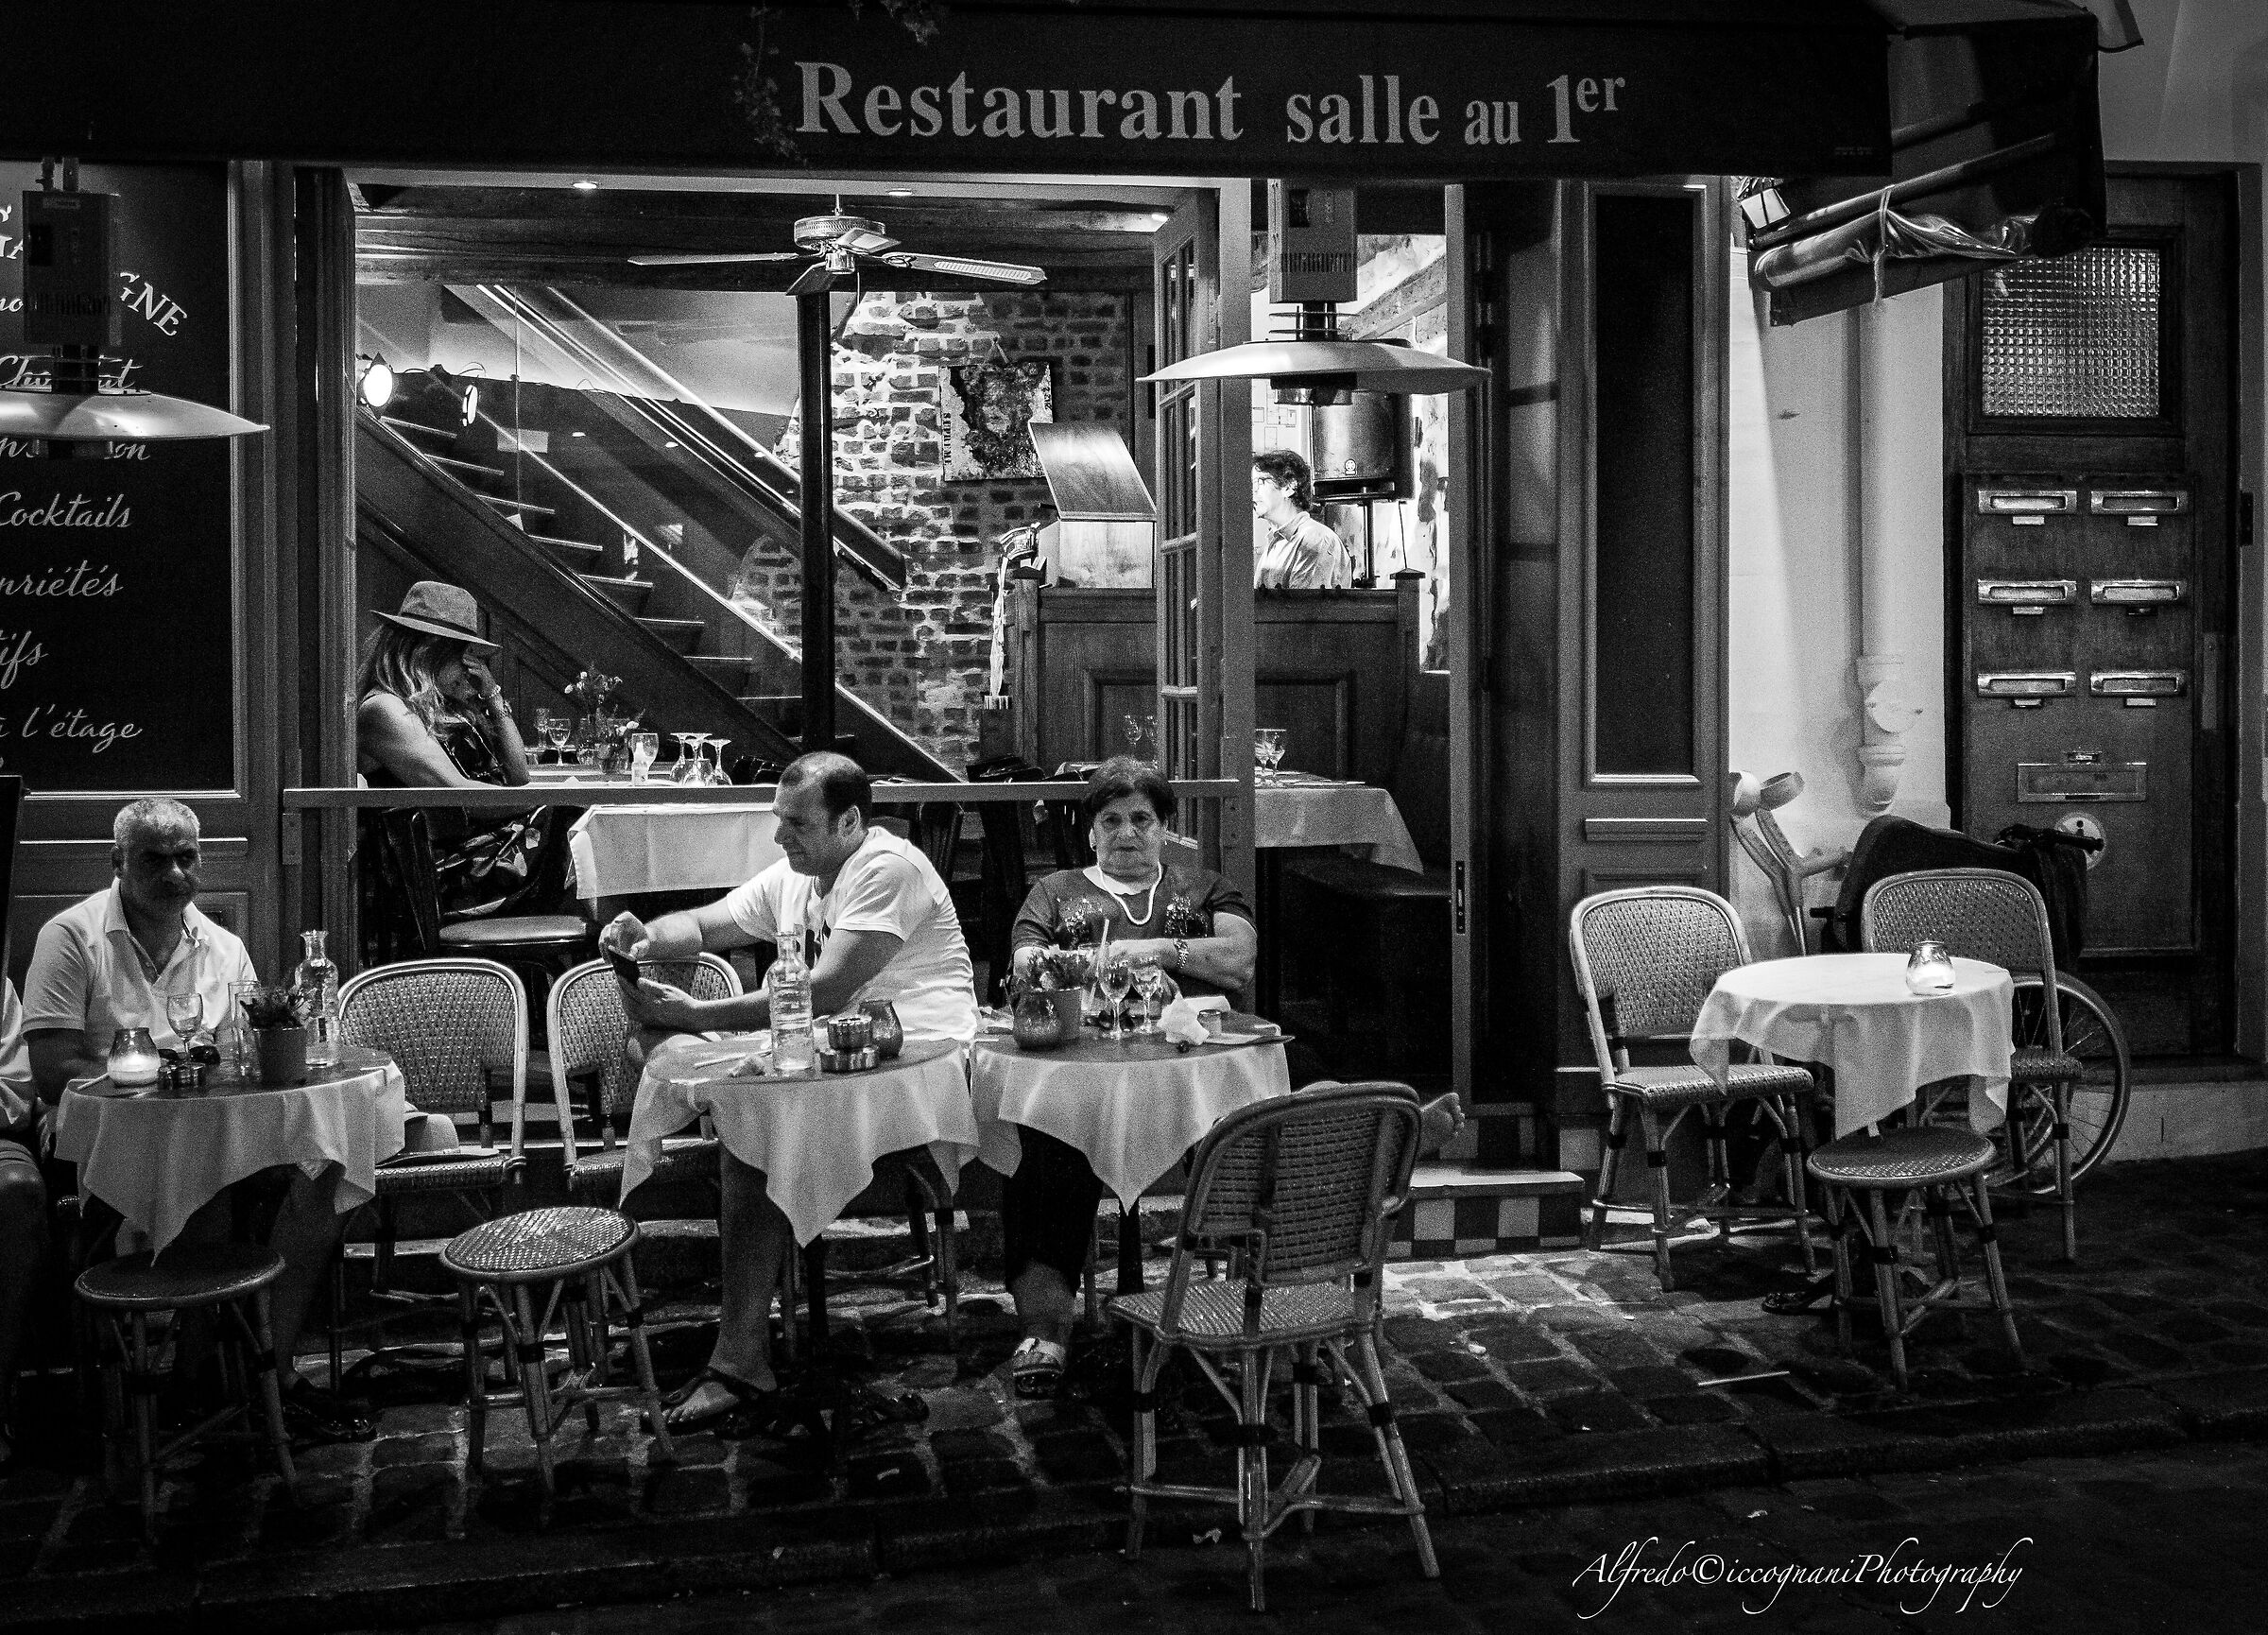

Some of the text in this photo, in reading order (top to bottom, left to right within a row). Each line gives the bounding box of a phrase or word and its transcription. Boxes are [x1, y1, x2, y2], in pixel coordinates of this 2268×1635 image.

[795, 61, 1625, 146] Restaurant salle au 1er
[0, 491, 132, 528] Cocktails
[22, 703, 144, 754] l'étage
